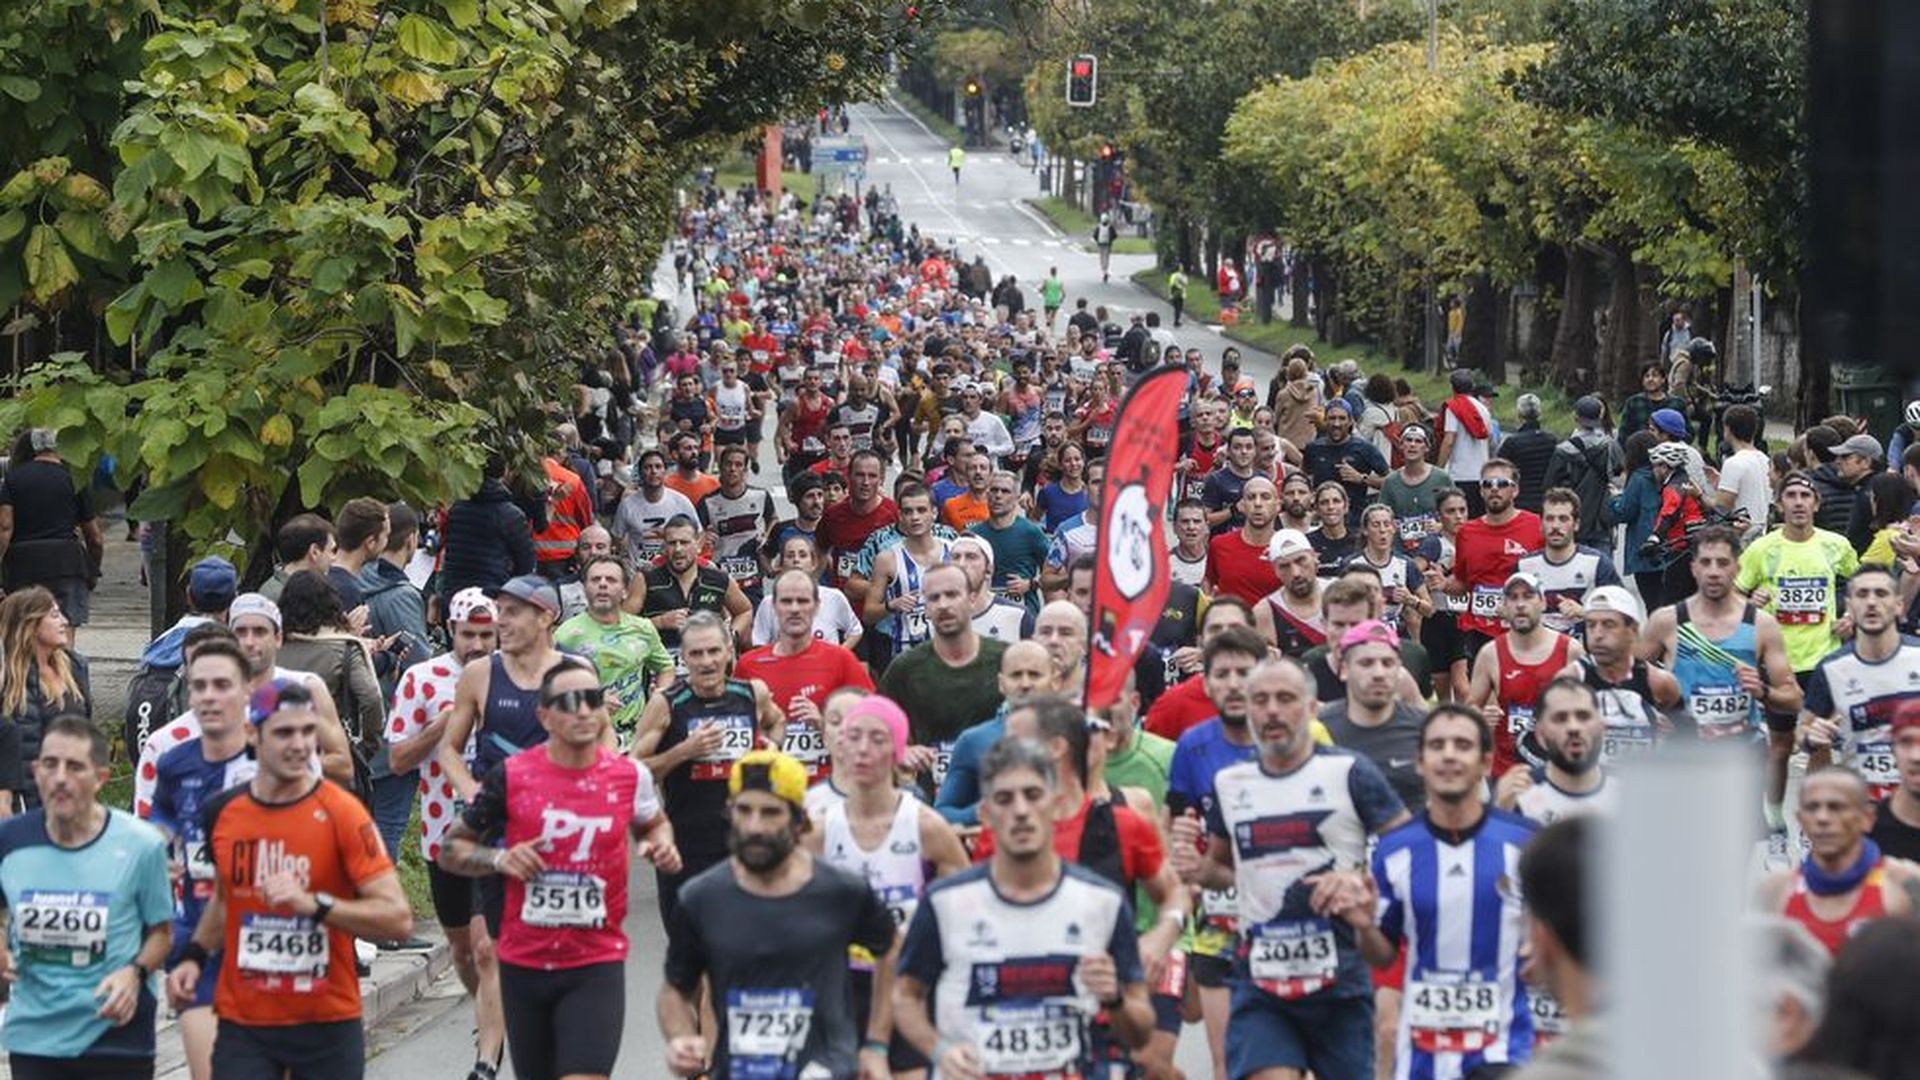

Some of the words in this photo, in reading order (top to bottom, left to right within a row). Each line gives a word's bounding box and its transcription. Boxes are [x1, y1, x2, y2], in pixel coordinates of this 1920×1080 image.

[1780, 587, 1827, 603] 3820
[1695, 694, 1749, 715] 5482
[725, 730, 751, 748] 25
[785, 734, 825, 751] 703
[1863, 756, 1897, 773] 45
[540, 807, 613, 862] PT
[530, 885, 601, 910] 5516
[23, 907, 101, 932] 2260
[247, 932, 324, 957] 5468
[1255, 936, 1330, 962] 3043
[1415, 987, 1494, 1011] 4358
[736, 1013, 806, 1037] 7259
[985, 1024, 1072, 1053] 4833
